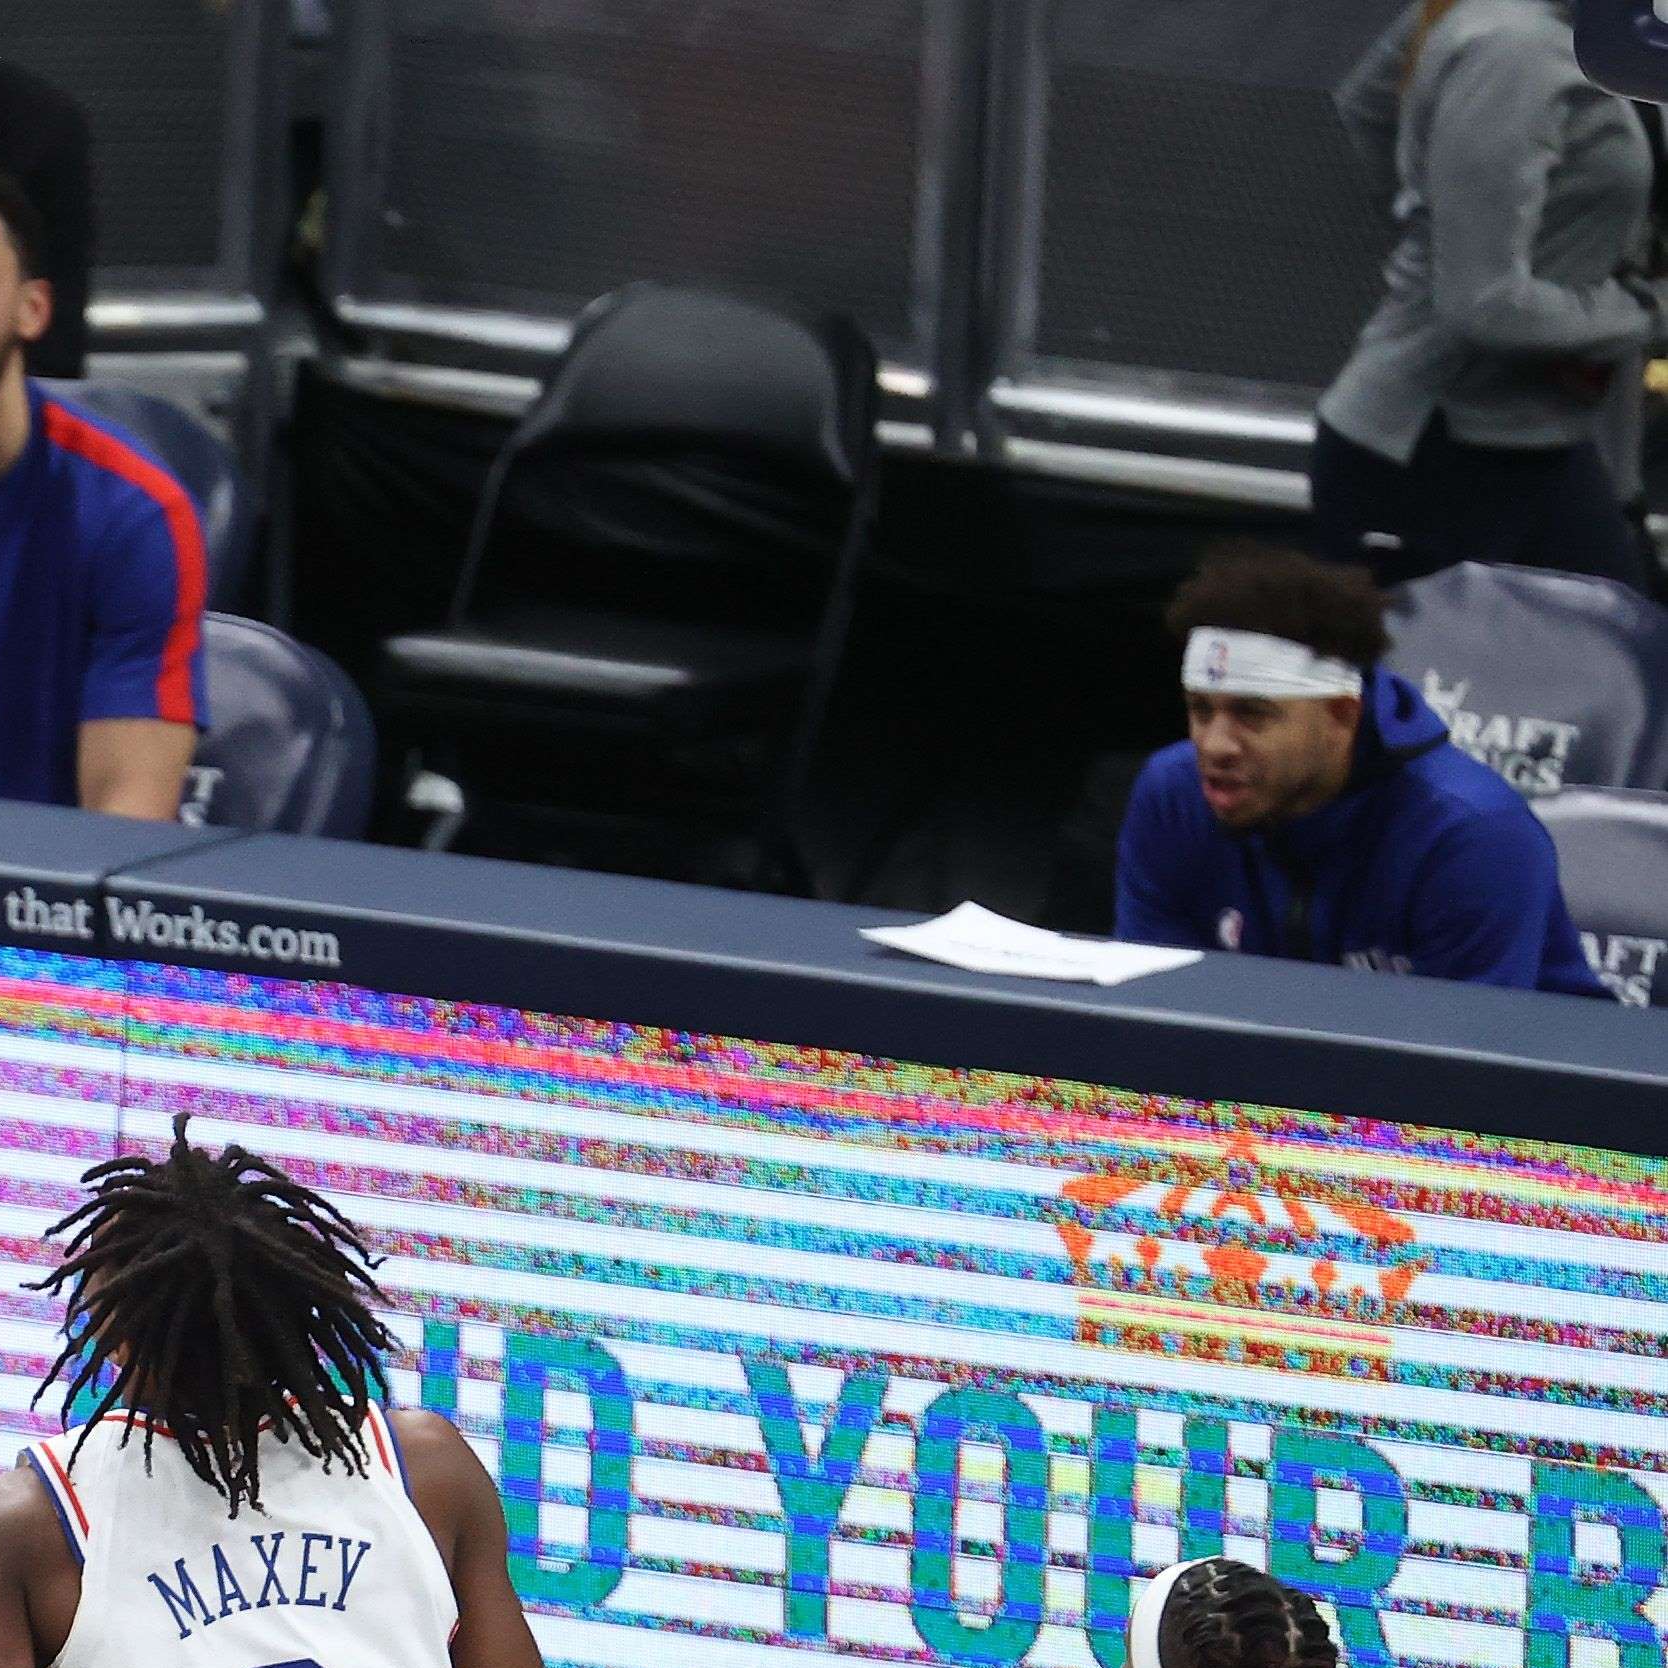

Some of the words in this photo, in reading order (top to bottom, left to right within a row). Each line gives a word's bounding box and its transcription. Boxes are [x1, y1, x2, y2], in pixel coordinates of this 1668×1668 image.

[5, 885, 94, 940] that
[104, 894, 342, 969] Works.com
[146, 1530, 373, 1641] MAXEY
